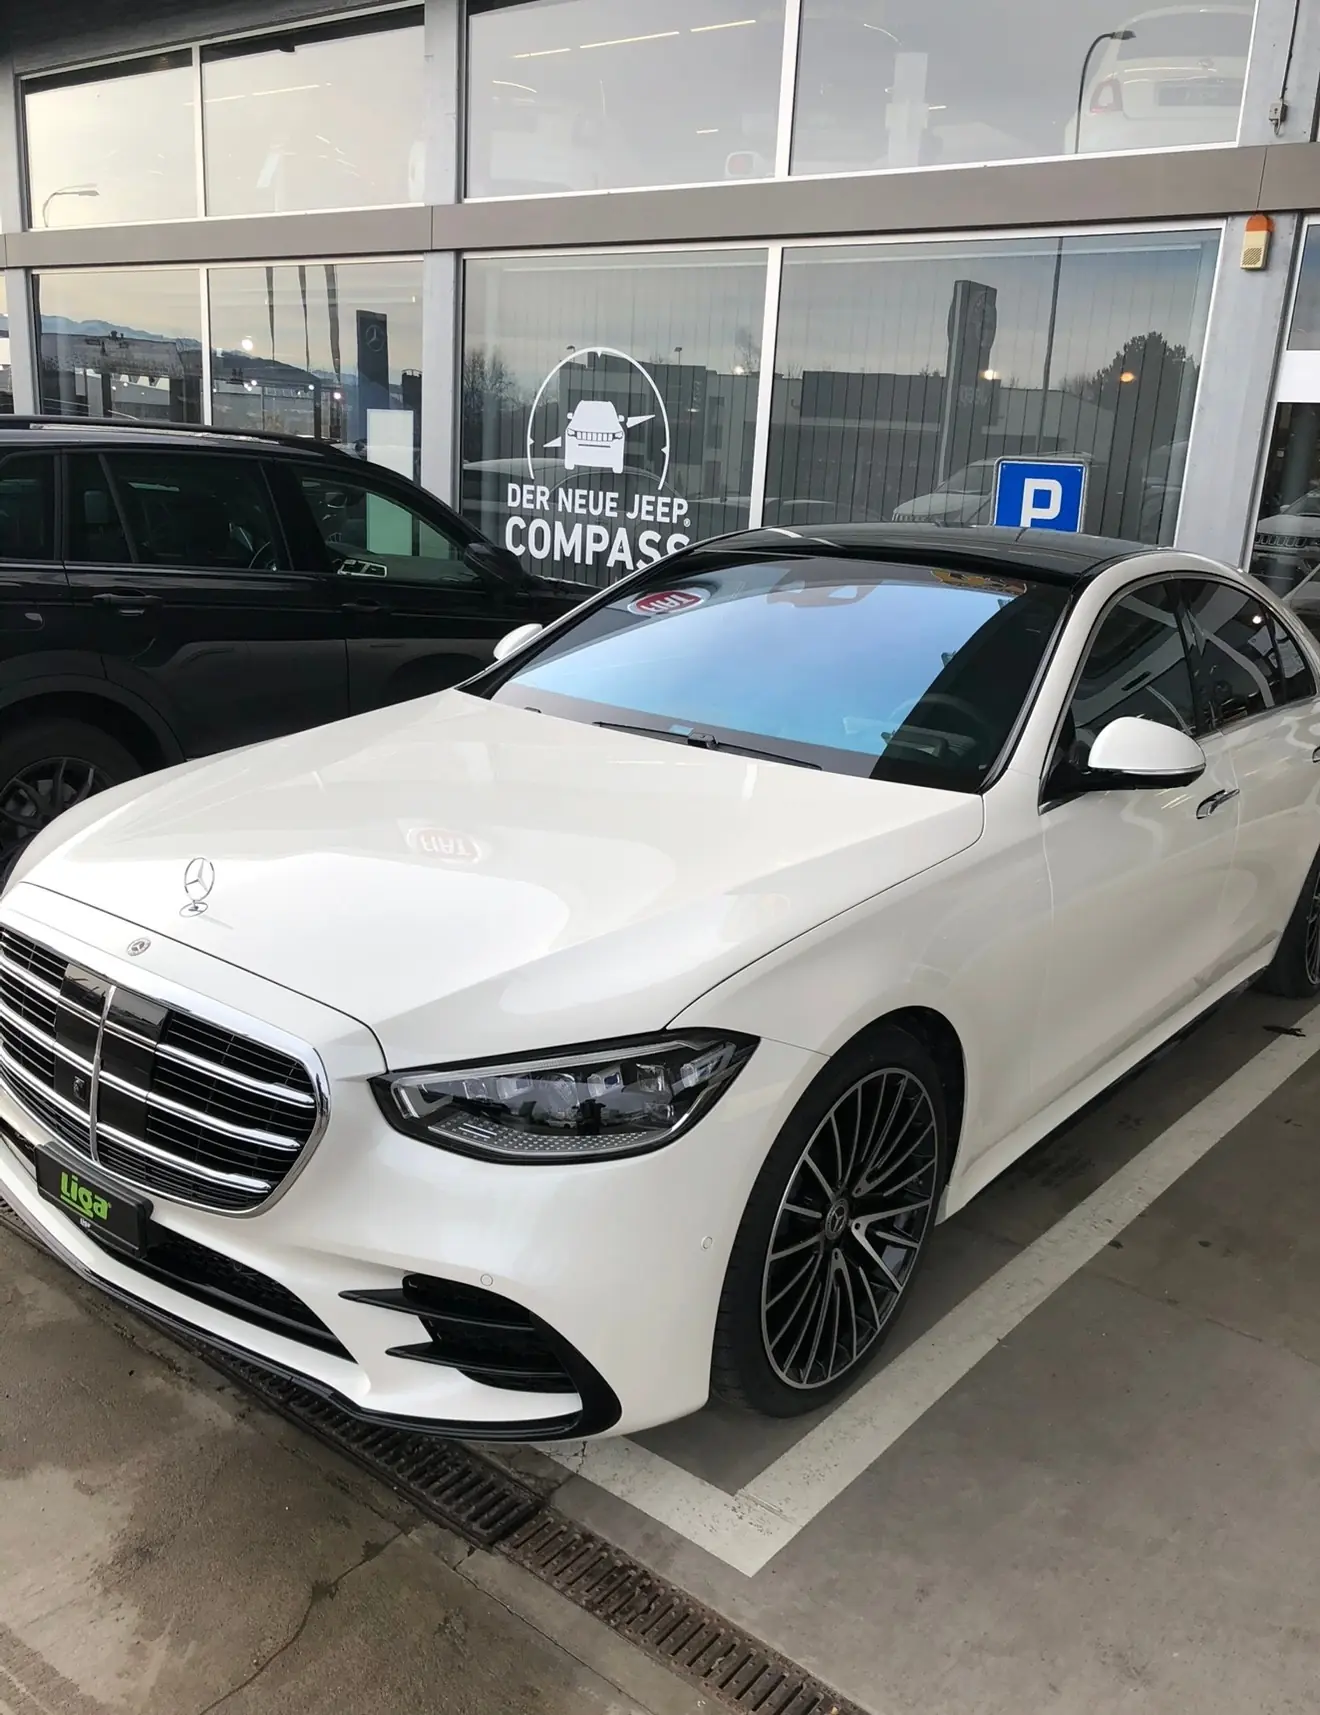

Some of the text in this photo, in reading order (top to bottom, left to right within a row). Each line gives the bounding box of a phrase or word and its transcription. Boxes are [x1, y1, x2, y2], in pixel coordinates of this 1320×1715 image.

[507, 483, 550, 511] DER
[557, 487, 619, 518] NEUE
[1020, 478, 1063, 528] P
